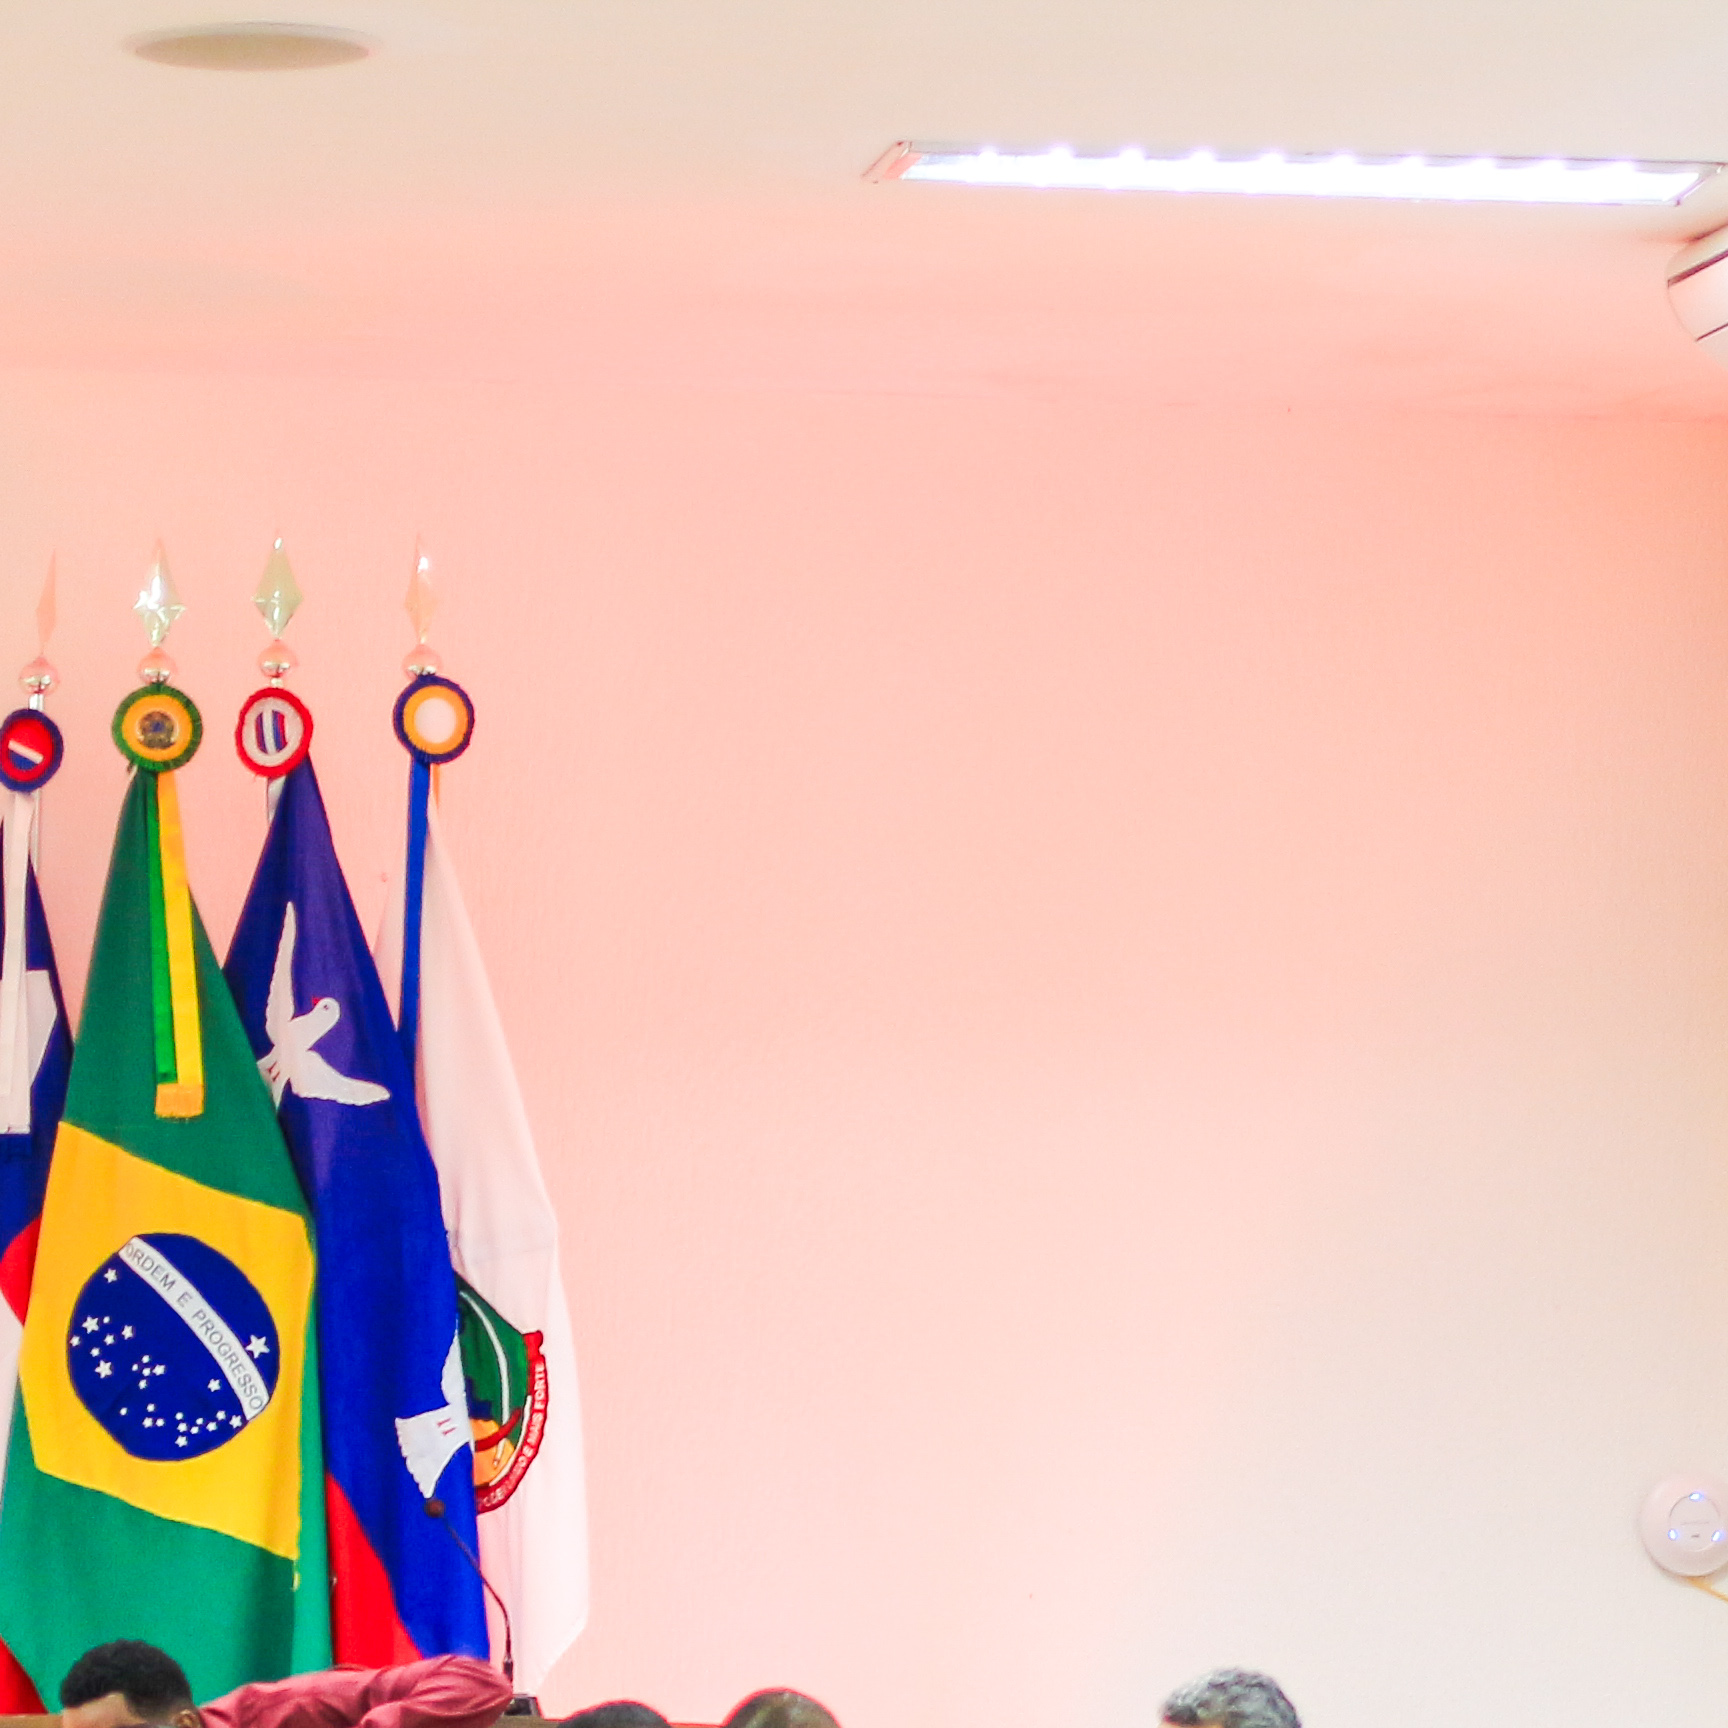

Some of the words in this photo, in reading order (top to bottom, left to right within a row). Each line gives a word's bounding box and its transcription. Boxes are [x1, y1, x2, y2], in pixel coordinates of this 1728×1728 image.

[126, 1243, 175, 1292] ORDEM
[176, 1291, 193, 1308] E
[192, 1310, 264, 1411] PROGRESSO
